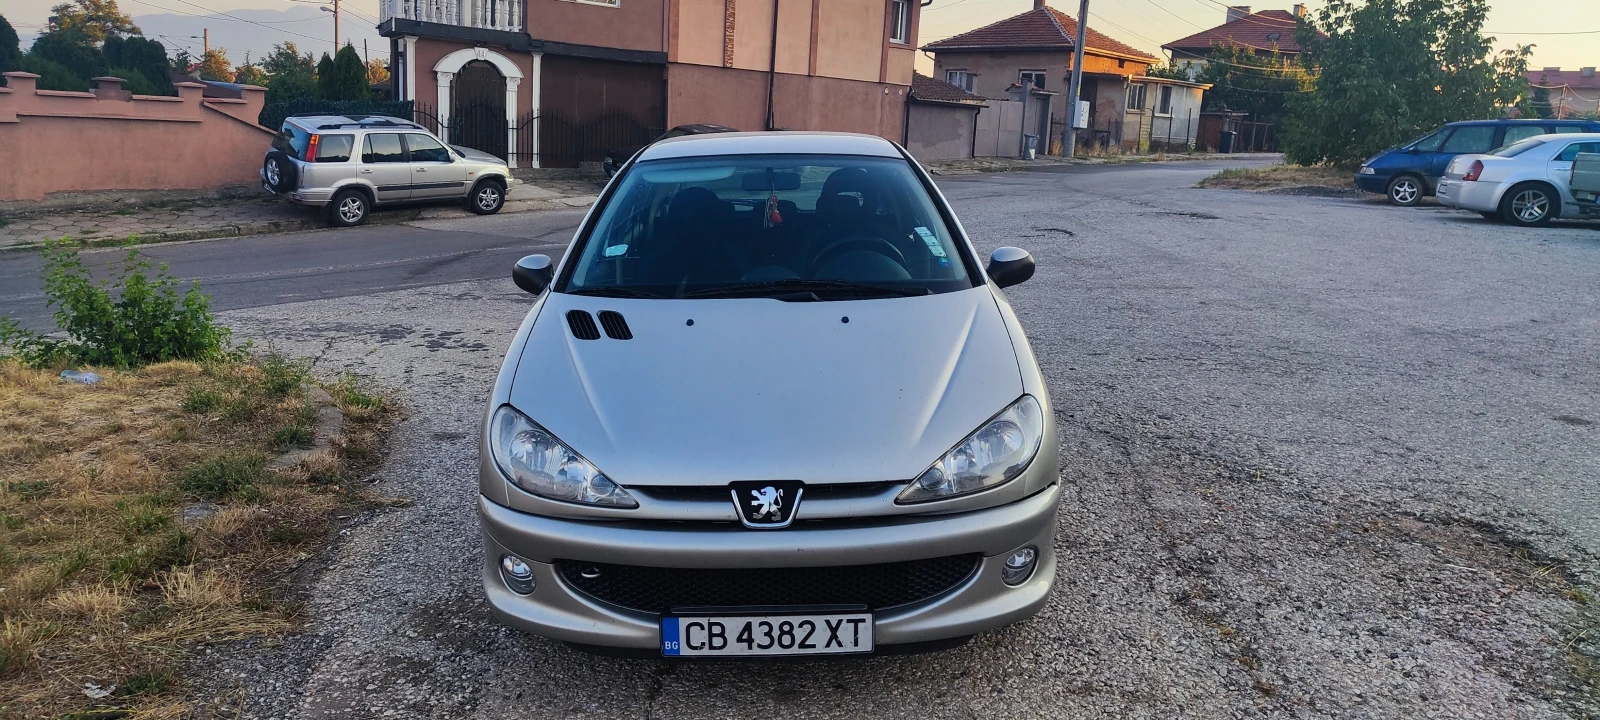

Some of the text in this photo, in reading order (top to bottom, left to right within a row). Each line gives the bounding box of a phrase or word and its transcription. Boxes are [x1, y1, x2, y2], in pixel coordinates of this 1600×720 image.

[685, 618, 867, 651] CB 4382 XT
[664, 641, 679, 650] BG
